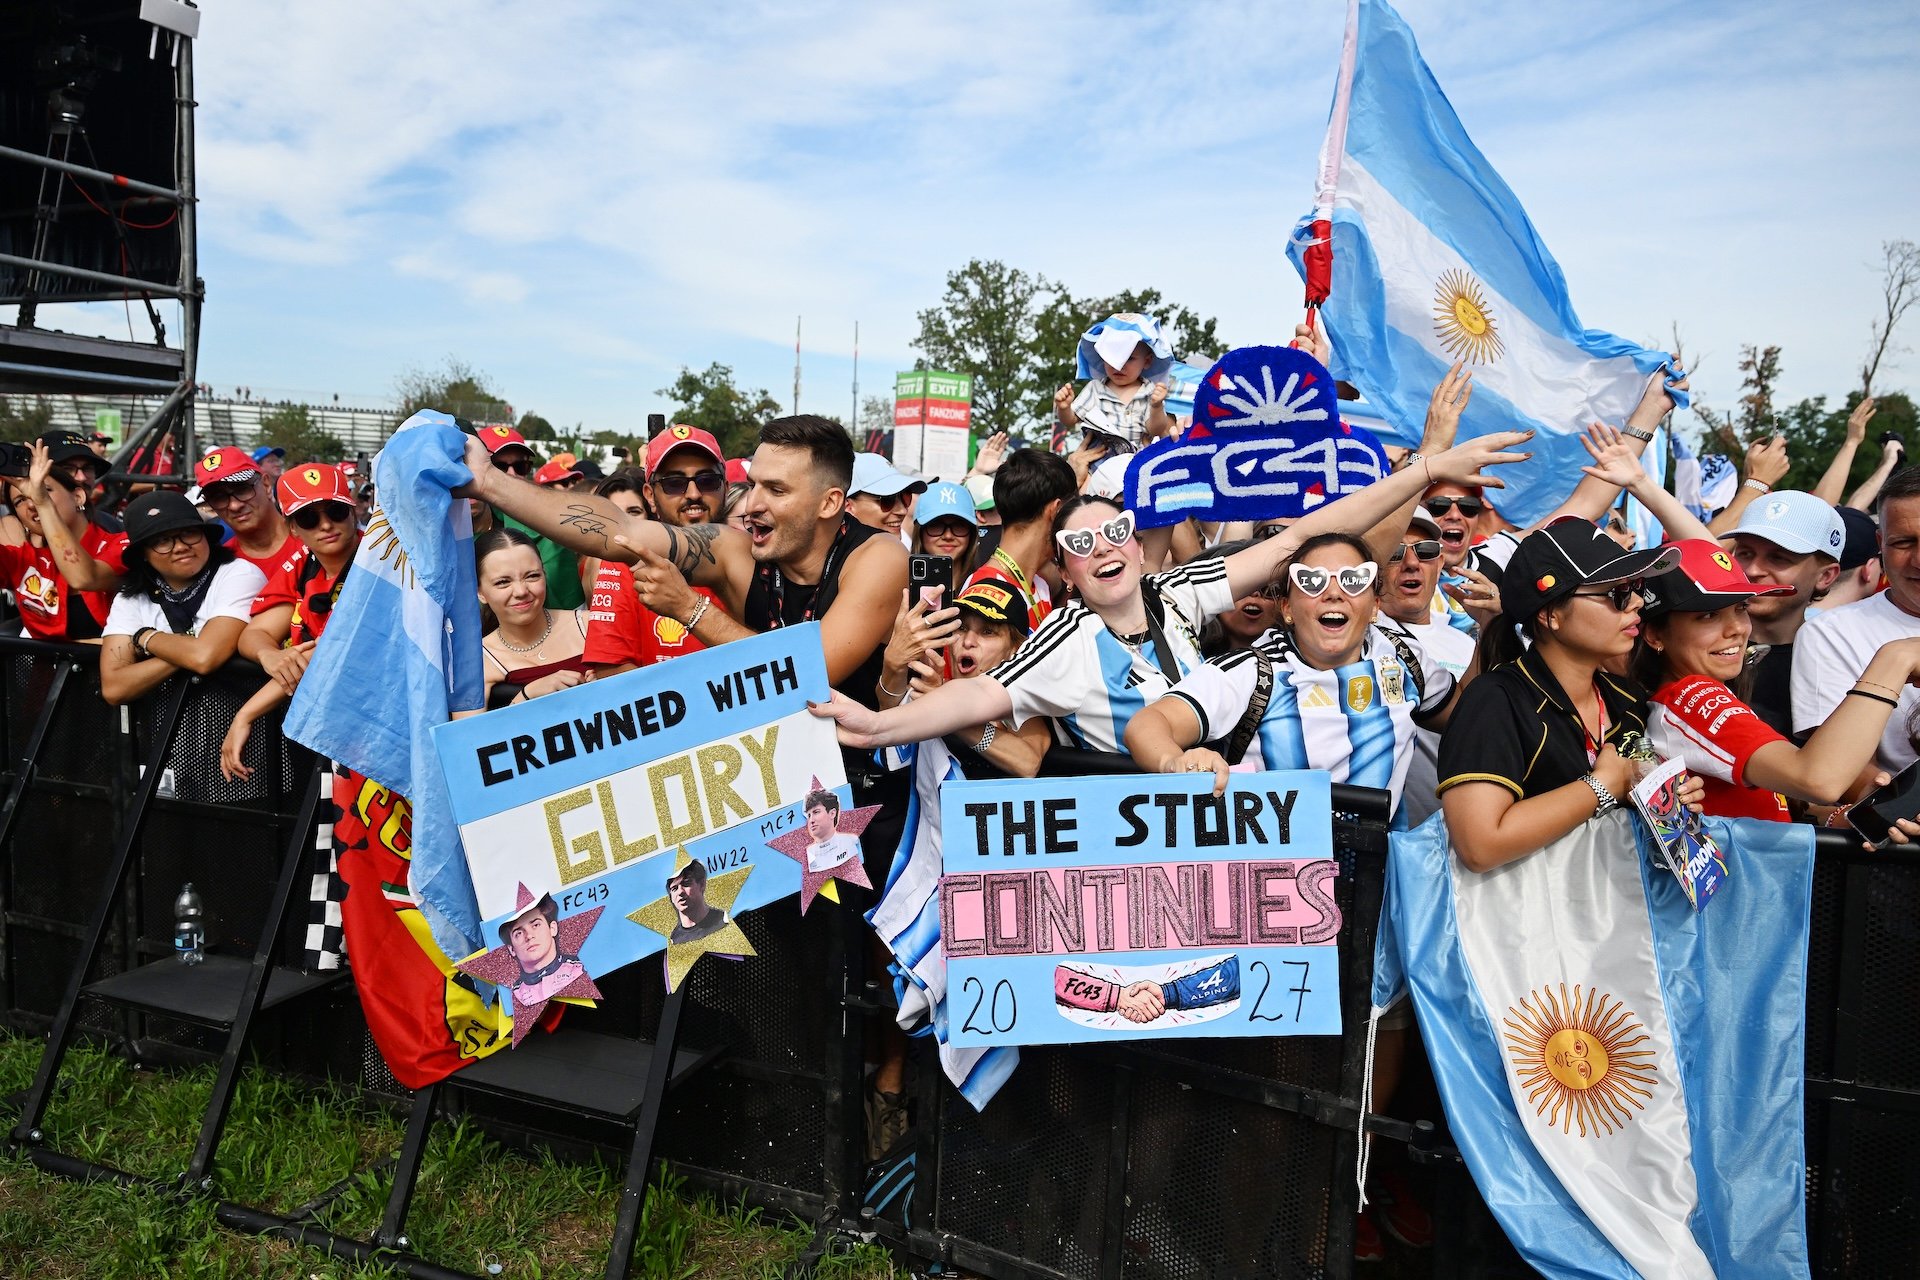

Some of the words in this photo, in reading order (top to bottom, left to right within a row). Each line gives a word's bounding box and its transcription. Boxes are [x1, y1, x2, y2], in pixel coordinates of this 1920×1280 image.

[929, 383, 958, 397] EXIT
[929, 406, 967, 421] FANZONE
[1136, 437, 1383, 508] FC43
[1071, 536, 1091, 551] FC
[1109, 524, 1127, 541] 43
[1341, 576, 1370, 587] ALPINE
[477, 690, 687, 787] CROWNED
[706, 655, 799, 713] WITH
[1698, 694, 1732, 720] ZCG
[543, 724, 782, 887] GLORY
[965, 798, 1079, 856] THE
[1115, 790, 1299, 848] STORY
[707, 846, 749, 873] NV22
[1683, 841, 1716, 883] MONZA
[563, 883, 610, 912] FC43
[939, 860, 1343, 957] CONTINUES
[1064, 977, 1103, 1001] FC43
[1190, 986, 1229, 1001] ALPINE
[1248, 960, 1312, 1023] 27
[961, 976, 1018, 1035] 20
